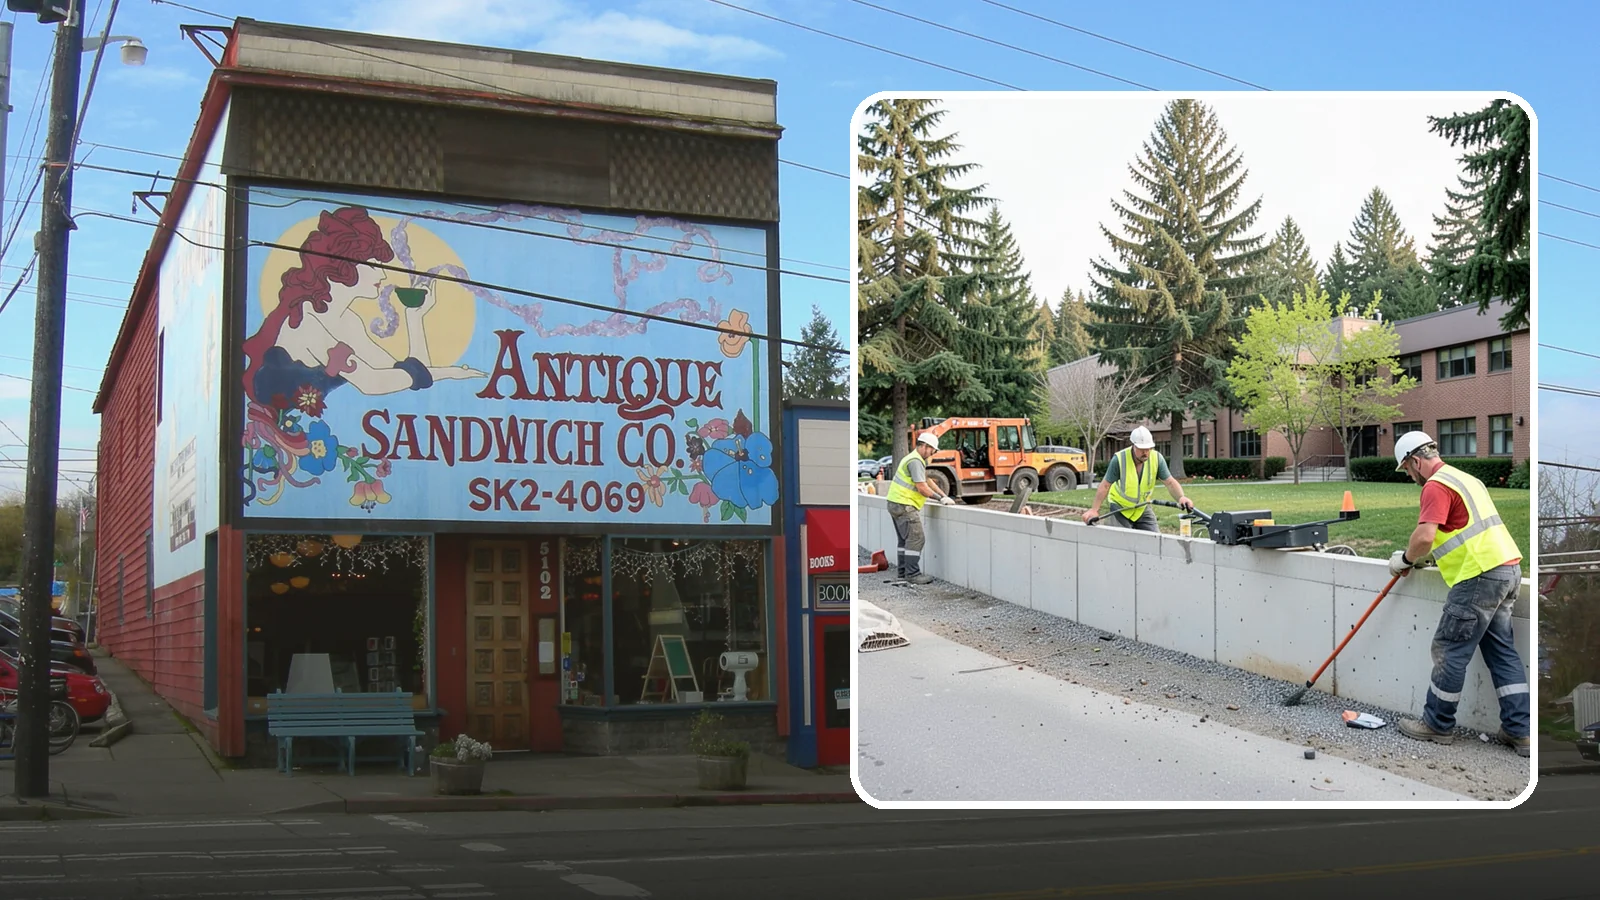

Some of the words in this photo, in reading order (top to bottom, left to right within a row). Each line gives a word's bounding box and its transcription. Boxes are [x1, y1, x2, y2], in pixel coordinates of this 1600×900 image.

[475, 329, 723, 421] ANTIQUE
[361, 408, 604, 467] SANDWICH
[617, 421, 685, 468] CO.
[468, 477, 646, 513] SK2-4069
[539, 541, 552, 600] 5102
[809, 555, 835, 569] BOOKS
